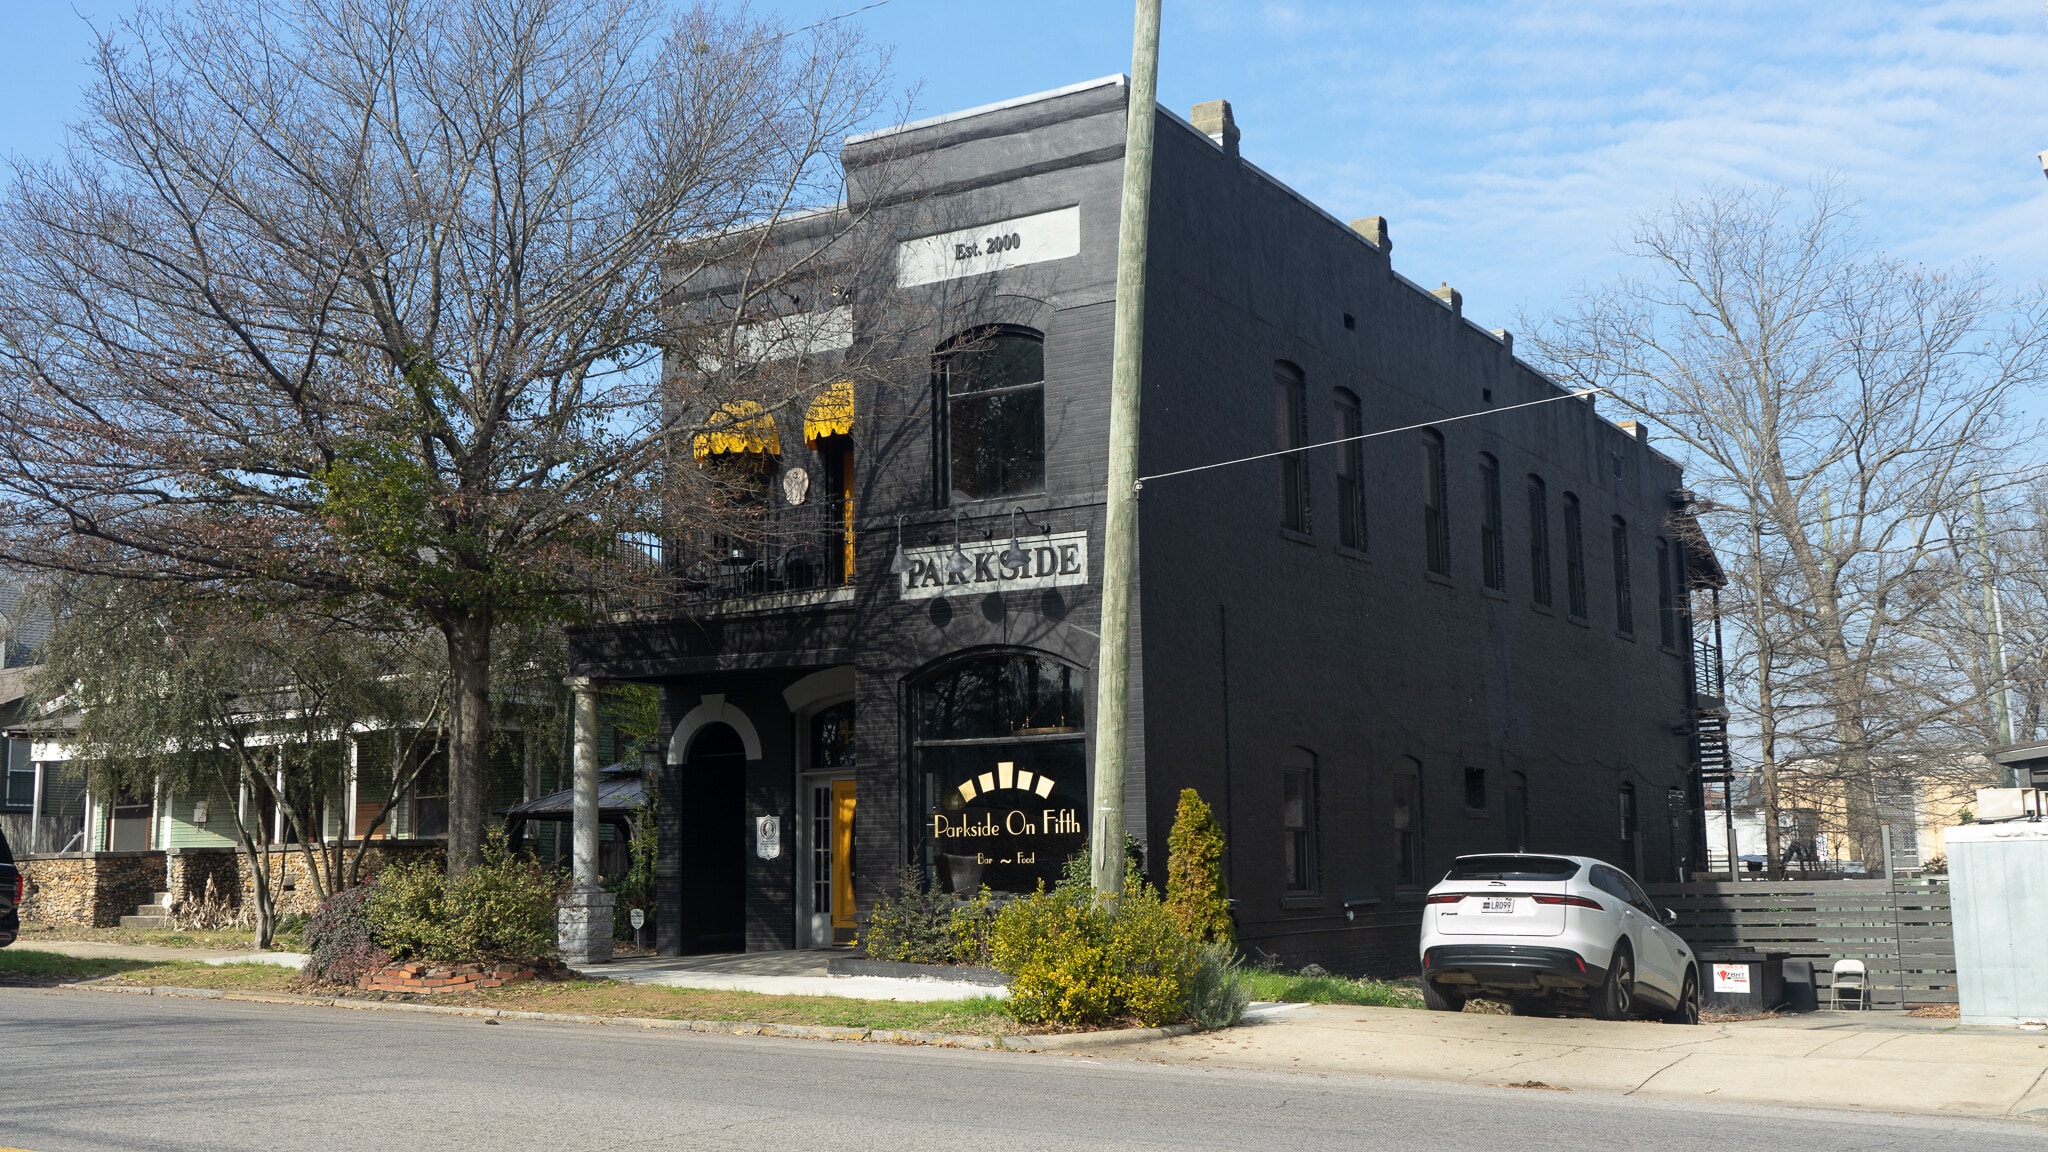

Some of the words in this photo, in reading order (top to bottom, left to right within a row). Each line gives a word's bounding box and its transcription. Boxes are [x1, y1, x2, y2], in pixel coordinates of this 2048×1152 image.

[955, 241, 982, 261] Est.
[986, 232, 1021, 254] 2000
[934, 812, 1000, 838] Parkside
[1005, 810, 1036, 836] On
[1043, 808, 1081, 835] Fifth
[977, 852, 993, 865] Bar
[1017, 851, 1035, 864] Food
